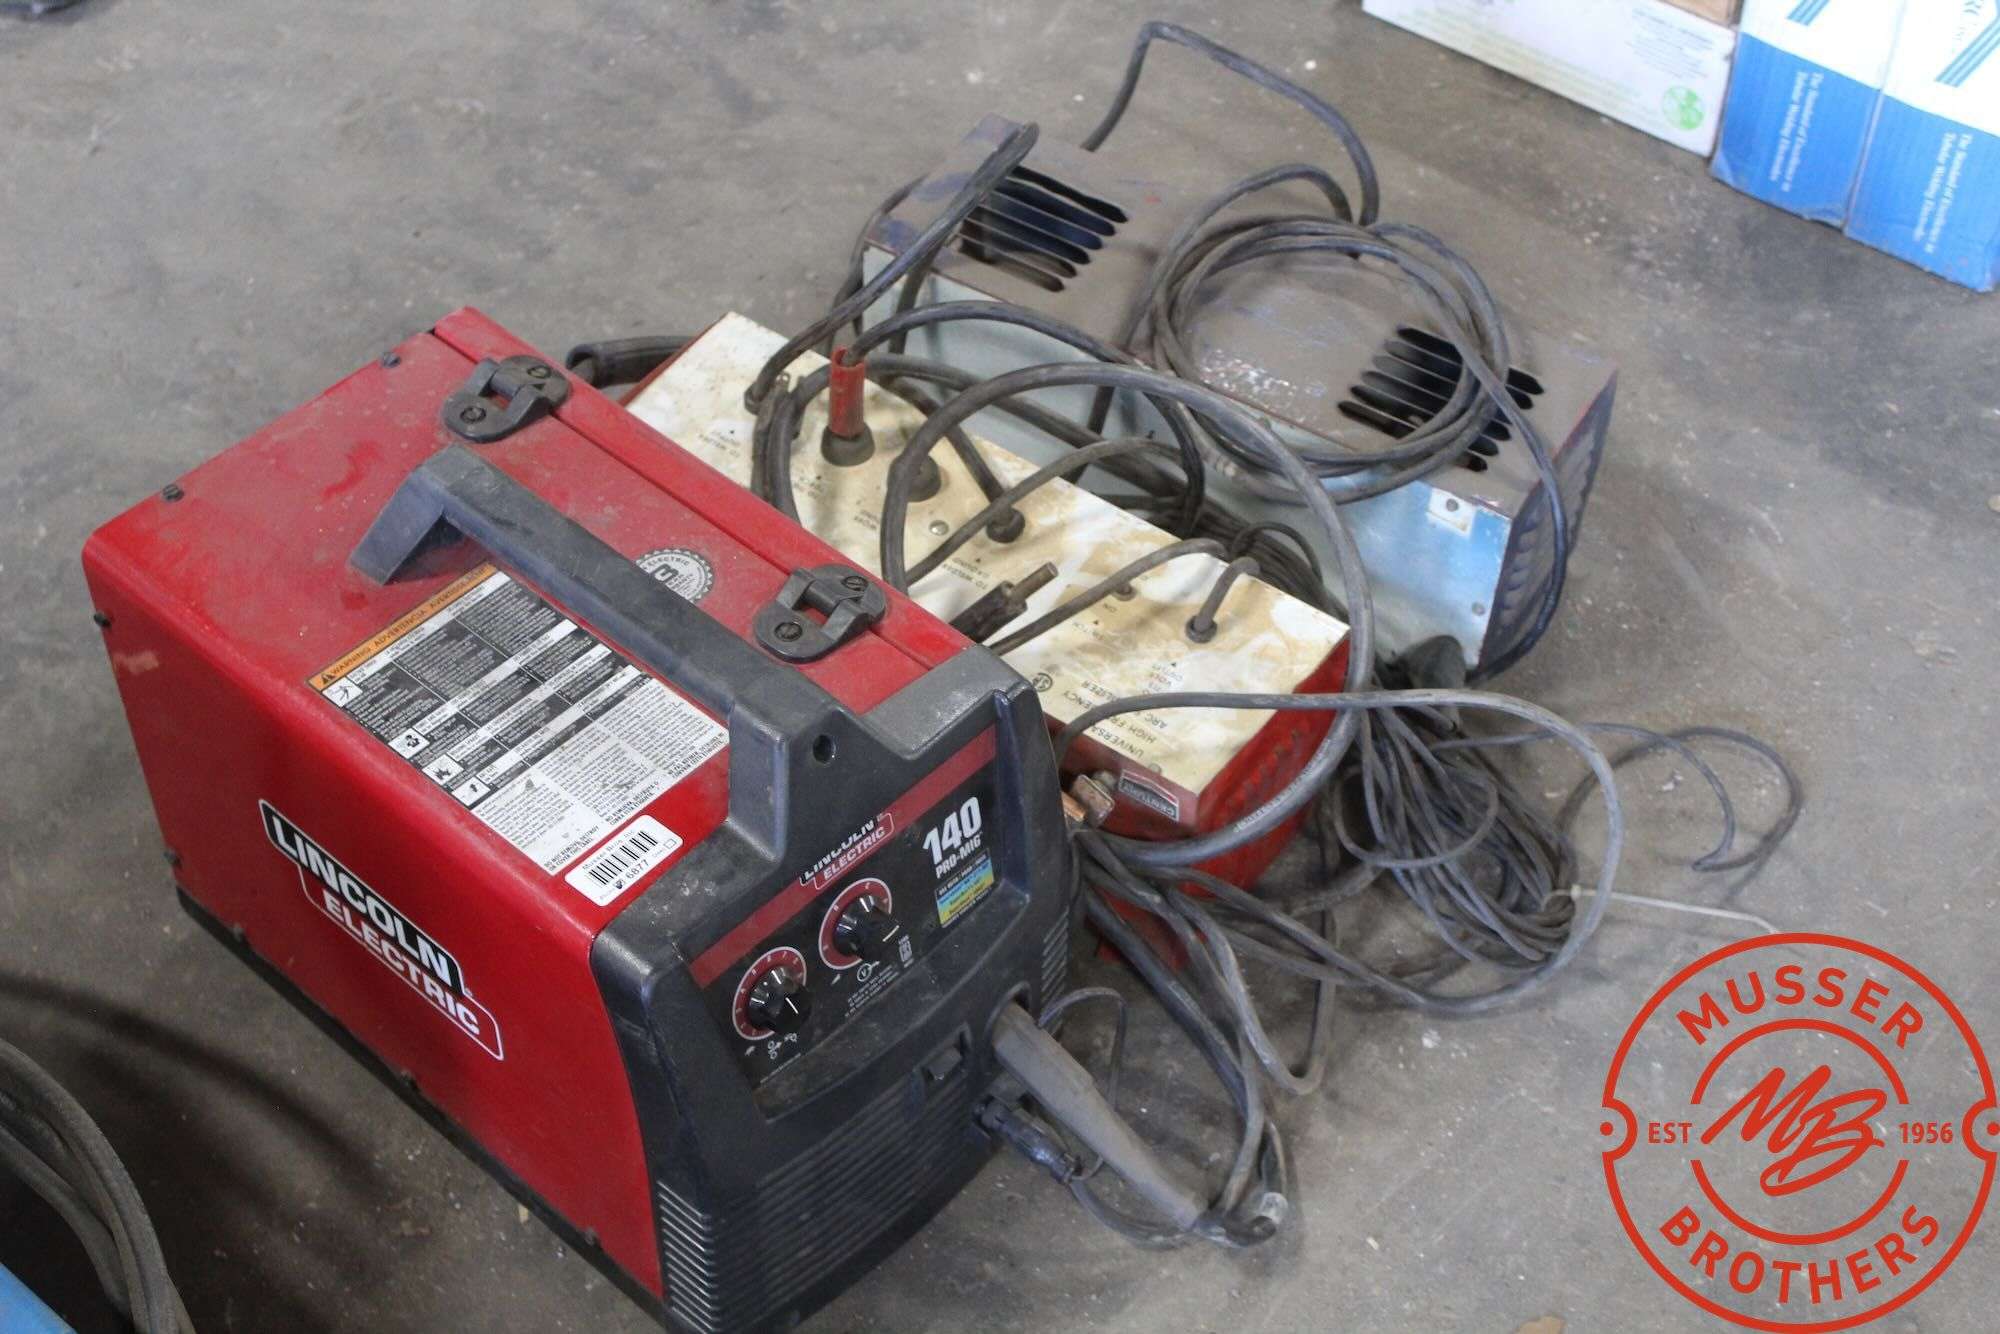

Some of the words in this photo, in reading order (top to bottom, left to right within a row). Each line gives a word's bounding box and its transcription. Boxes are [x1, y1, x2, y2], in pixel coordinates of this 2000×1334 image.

[1090, 724, 1145, 759] UNIVERSA
[1144, 713, 1169, 731] ARC
[822, 826, 886, 880] ELECTRIC
[922, 796, 982, 865] 140
[623, 858, 651, 881] 6877
[935, 834, 982, 879] PRO-MIG
[272, 815, 454, 988] LINCOLN
[323, 888, 480, 1035] ELECTRIC
